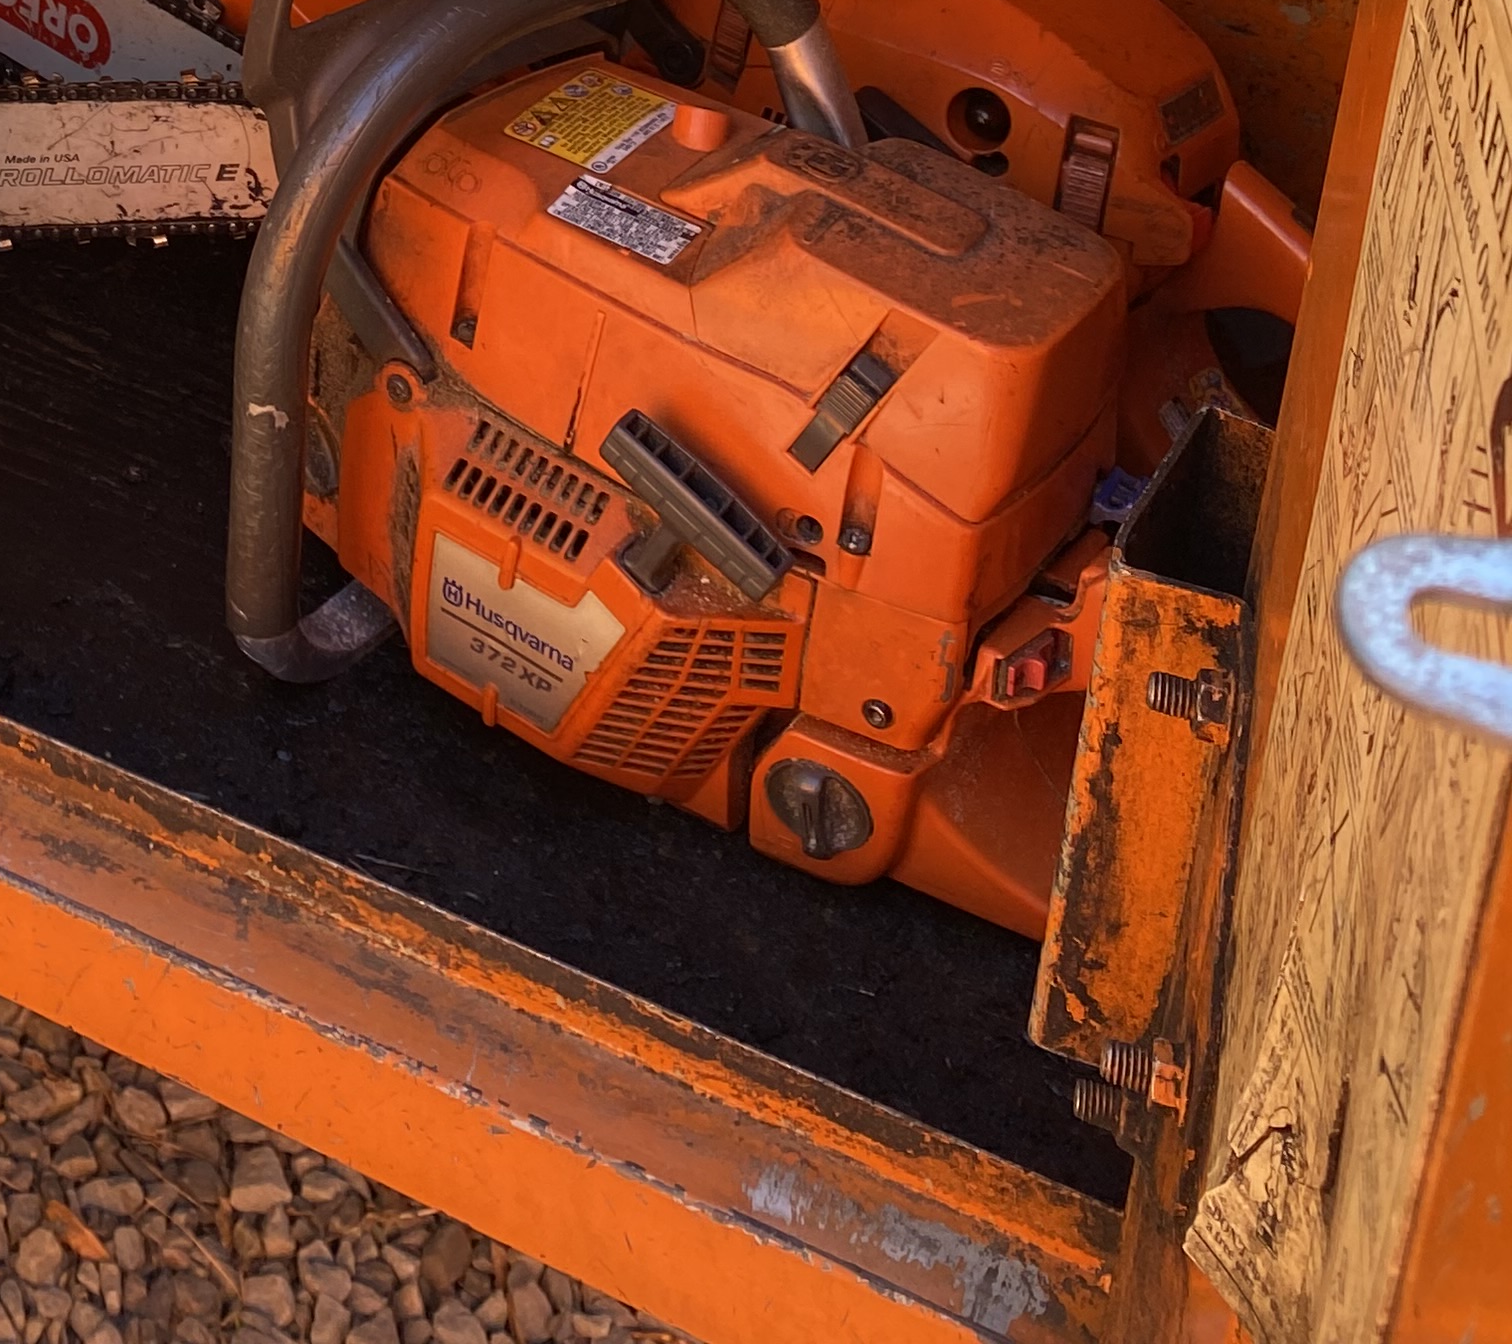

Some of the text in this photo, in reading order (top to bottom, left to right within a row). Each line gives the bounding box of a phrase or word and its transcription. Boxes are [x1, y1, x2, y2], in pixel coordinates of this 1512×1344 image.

[4, 152, 80, 165] Made in USA
[465, 592, 575, 673] Husqvarna
